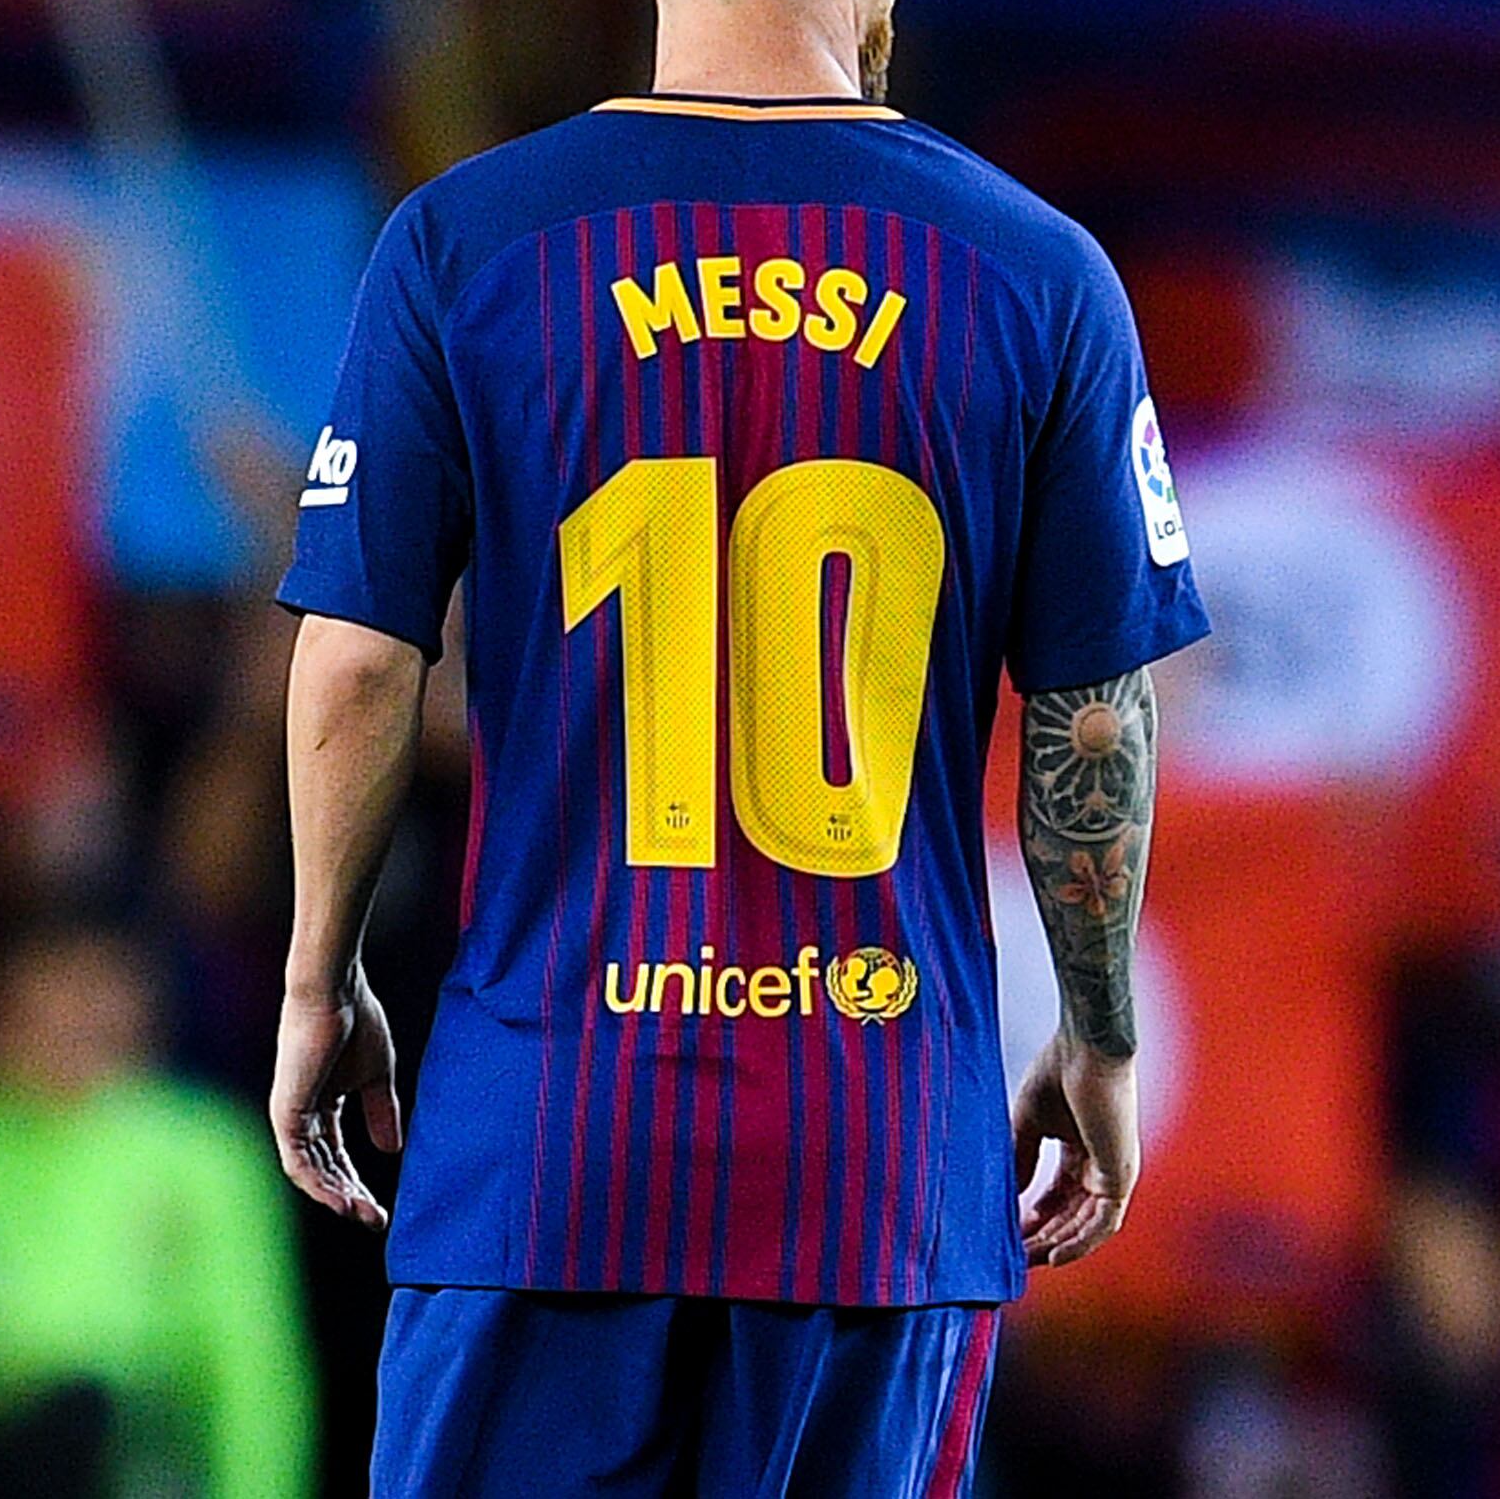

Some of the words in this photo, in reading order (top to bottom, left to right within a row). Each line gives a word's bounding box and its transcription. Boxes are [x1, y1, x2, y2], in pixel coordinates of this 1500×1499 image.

[610, 256, 907, 370] MESSI
[558, 456, 946, 878] 10
[604, 945, 820, 1018] unicef
